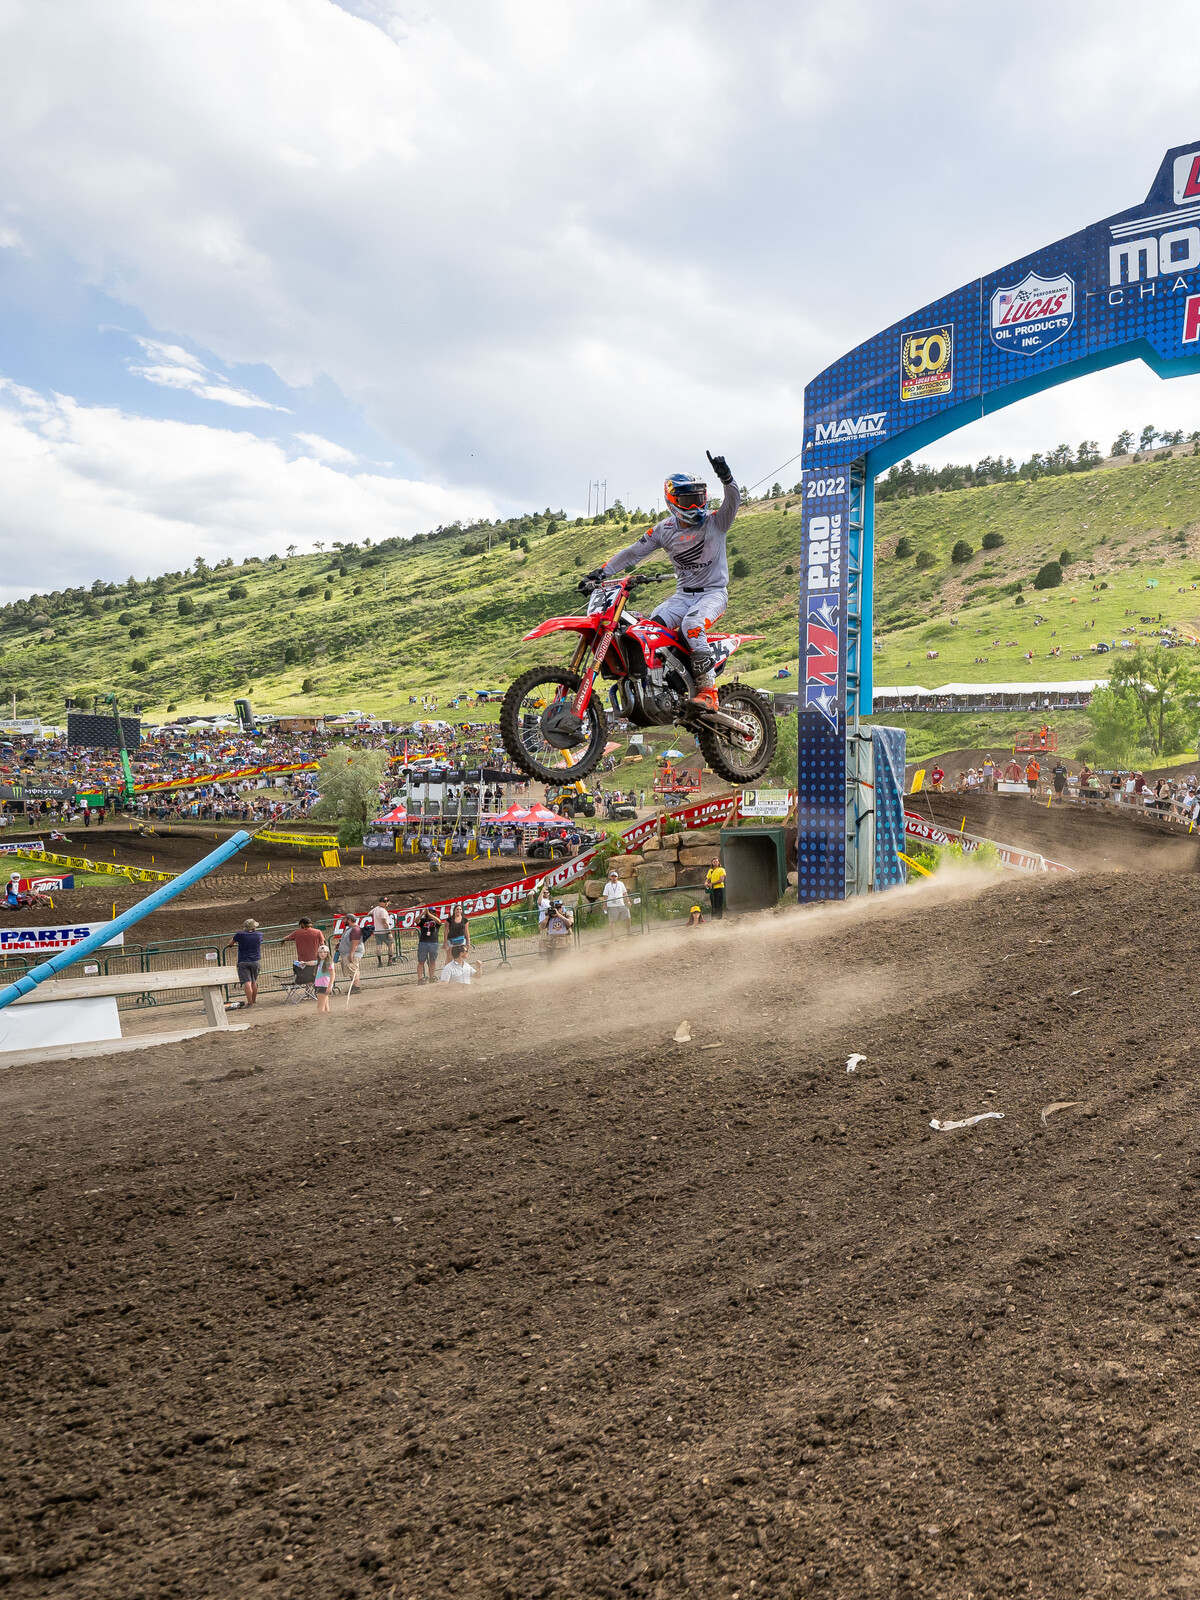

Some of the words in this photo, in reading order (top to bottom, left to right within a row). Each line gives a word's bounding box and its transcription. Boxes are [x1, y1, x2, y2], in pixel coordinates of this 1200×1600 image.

[1000, 294, 1067, 325] LUCAS
[995, 330, 1012, 340] OIL
[1015, 318, 1068, 336] PRODUCTS
[1022, 336, 1042, 347] INC.
[909, 335, 946, 373] 50
[815, 435, 857, 446] MOTORSPORTS
[859, 430, 887, 439] NETWORK
[807, 477, 845, 498] 2022
[808, 516, 830, 590] PRO
[830, 514, 841, 587] RACING
[677, 561, 713, 570] HONDA
[598, 632, 613, 661] SHOWA
[576, 678, 590, 711] DUNLOP
[500, 884, 527, 905] OIL
[1, 928, 90, 943] PARTS
[1, 938, 84, 950] UNLIMITE
